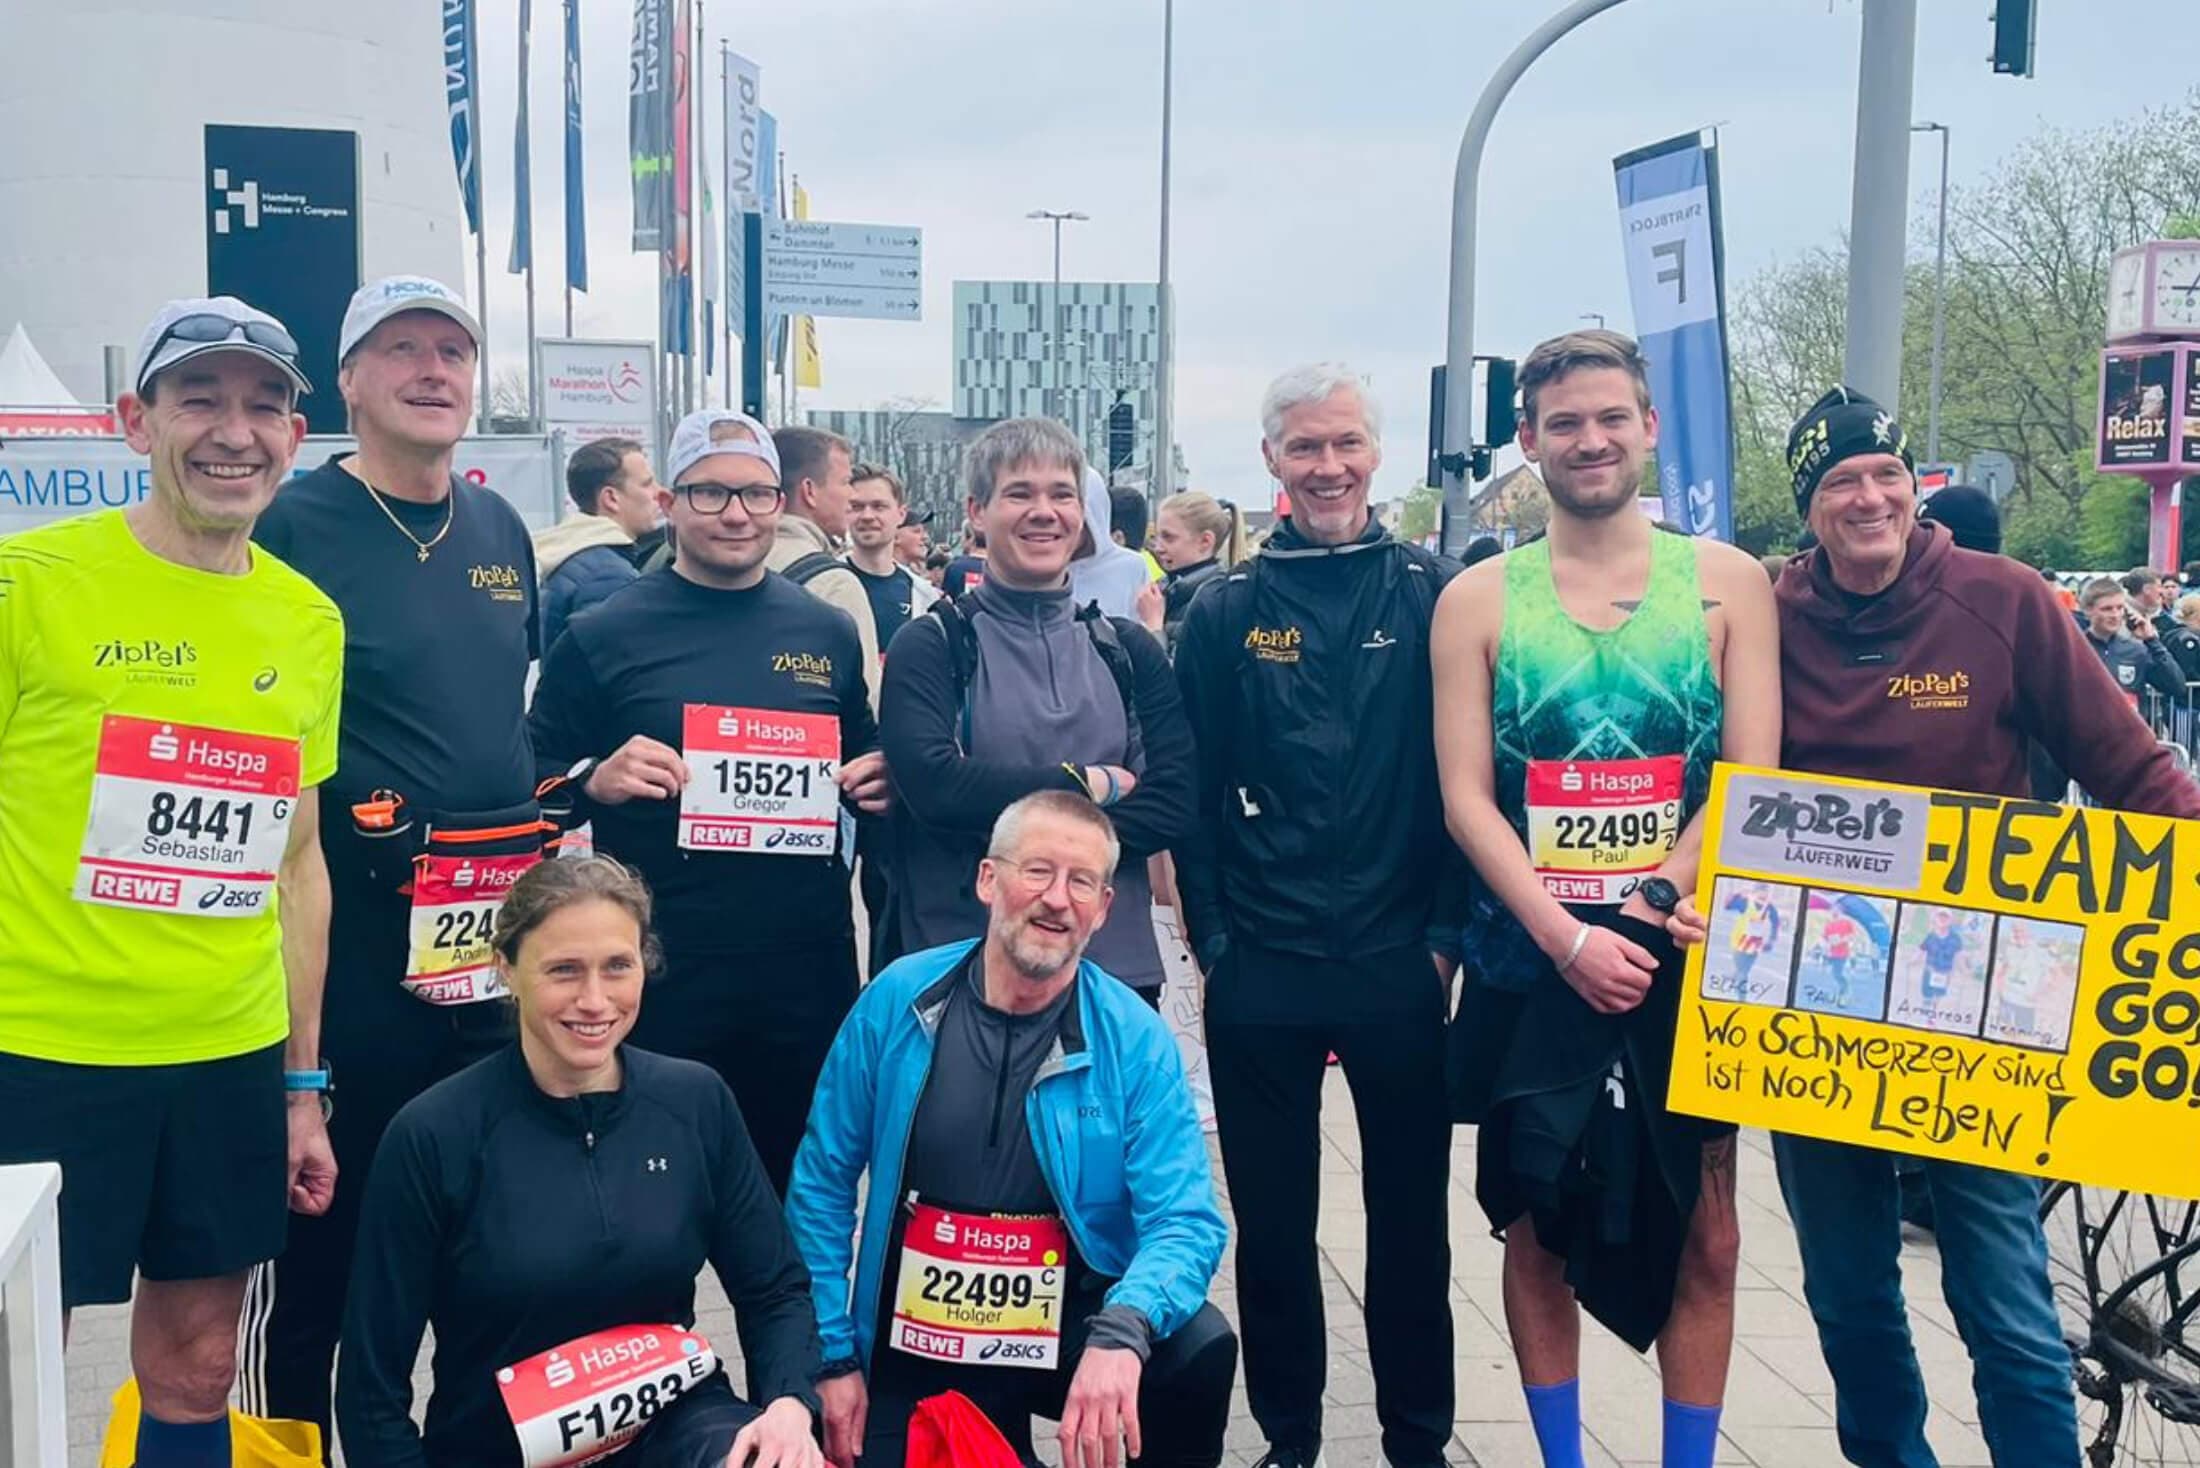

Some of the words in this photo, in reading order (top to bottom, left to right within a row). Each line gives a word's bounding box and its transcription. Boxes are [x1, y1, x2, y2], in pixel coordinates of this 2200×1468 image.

[262, 192, 306, 205] Hamburg
[303, 206, 348, 218] Congress
[768, 255, 819, 270] Hamburg
[384, 281, 447, 297] HOKA
[549, 378, 607, 390] Marathon
[560, 391, 613, 405] Hamburg
[2107, 414, 2166, 440] Relax
[745, 719, 807, 744] Haspa
[187, 739, 268, 775] Haspa
[713, 759, 811, 798] 15521
[818, 761, 833, 778] K
[1589, 772, 1654, 794] Haspa
[733, 795, 787, 813] Gregor
[146, 791, 254, 846] 8441
[272, 799, 289, 821] G
[1555, 811, 1658, 849] 22499
[692, 826, 750, 845] REWE
[141, 834, 245, 864] Sebastian
[1591, 849, 1629, 864] Paul
[94, 875, 178, 903] REWE
[1546, 879, 1601, 898] REWE
[433, 907, 494, 949] 224
[1698, 1005, 1748, 1048] Wo
[1704, 1051, 1750, 1092] ist
[963, 1227, 1032, 1253] Haspa
[921, 1265, 1033, 1309] 22499
[946, 1306, 1003, 1326] Holger
[579, 1333, 661, 1374] Haspa
[903, 1328, 962, 1357] REWE
[687, 1355, 705, 1379] E
